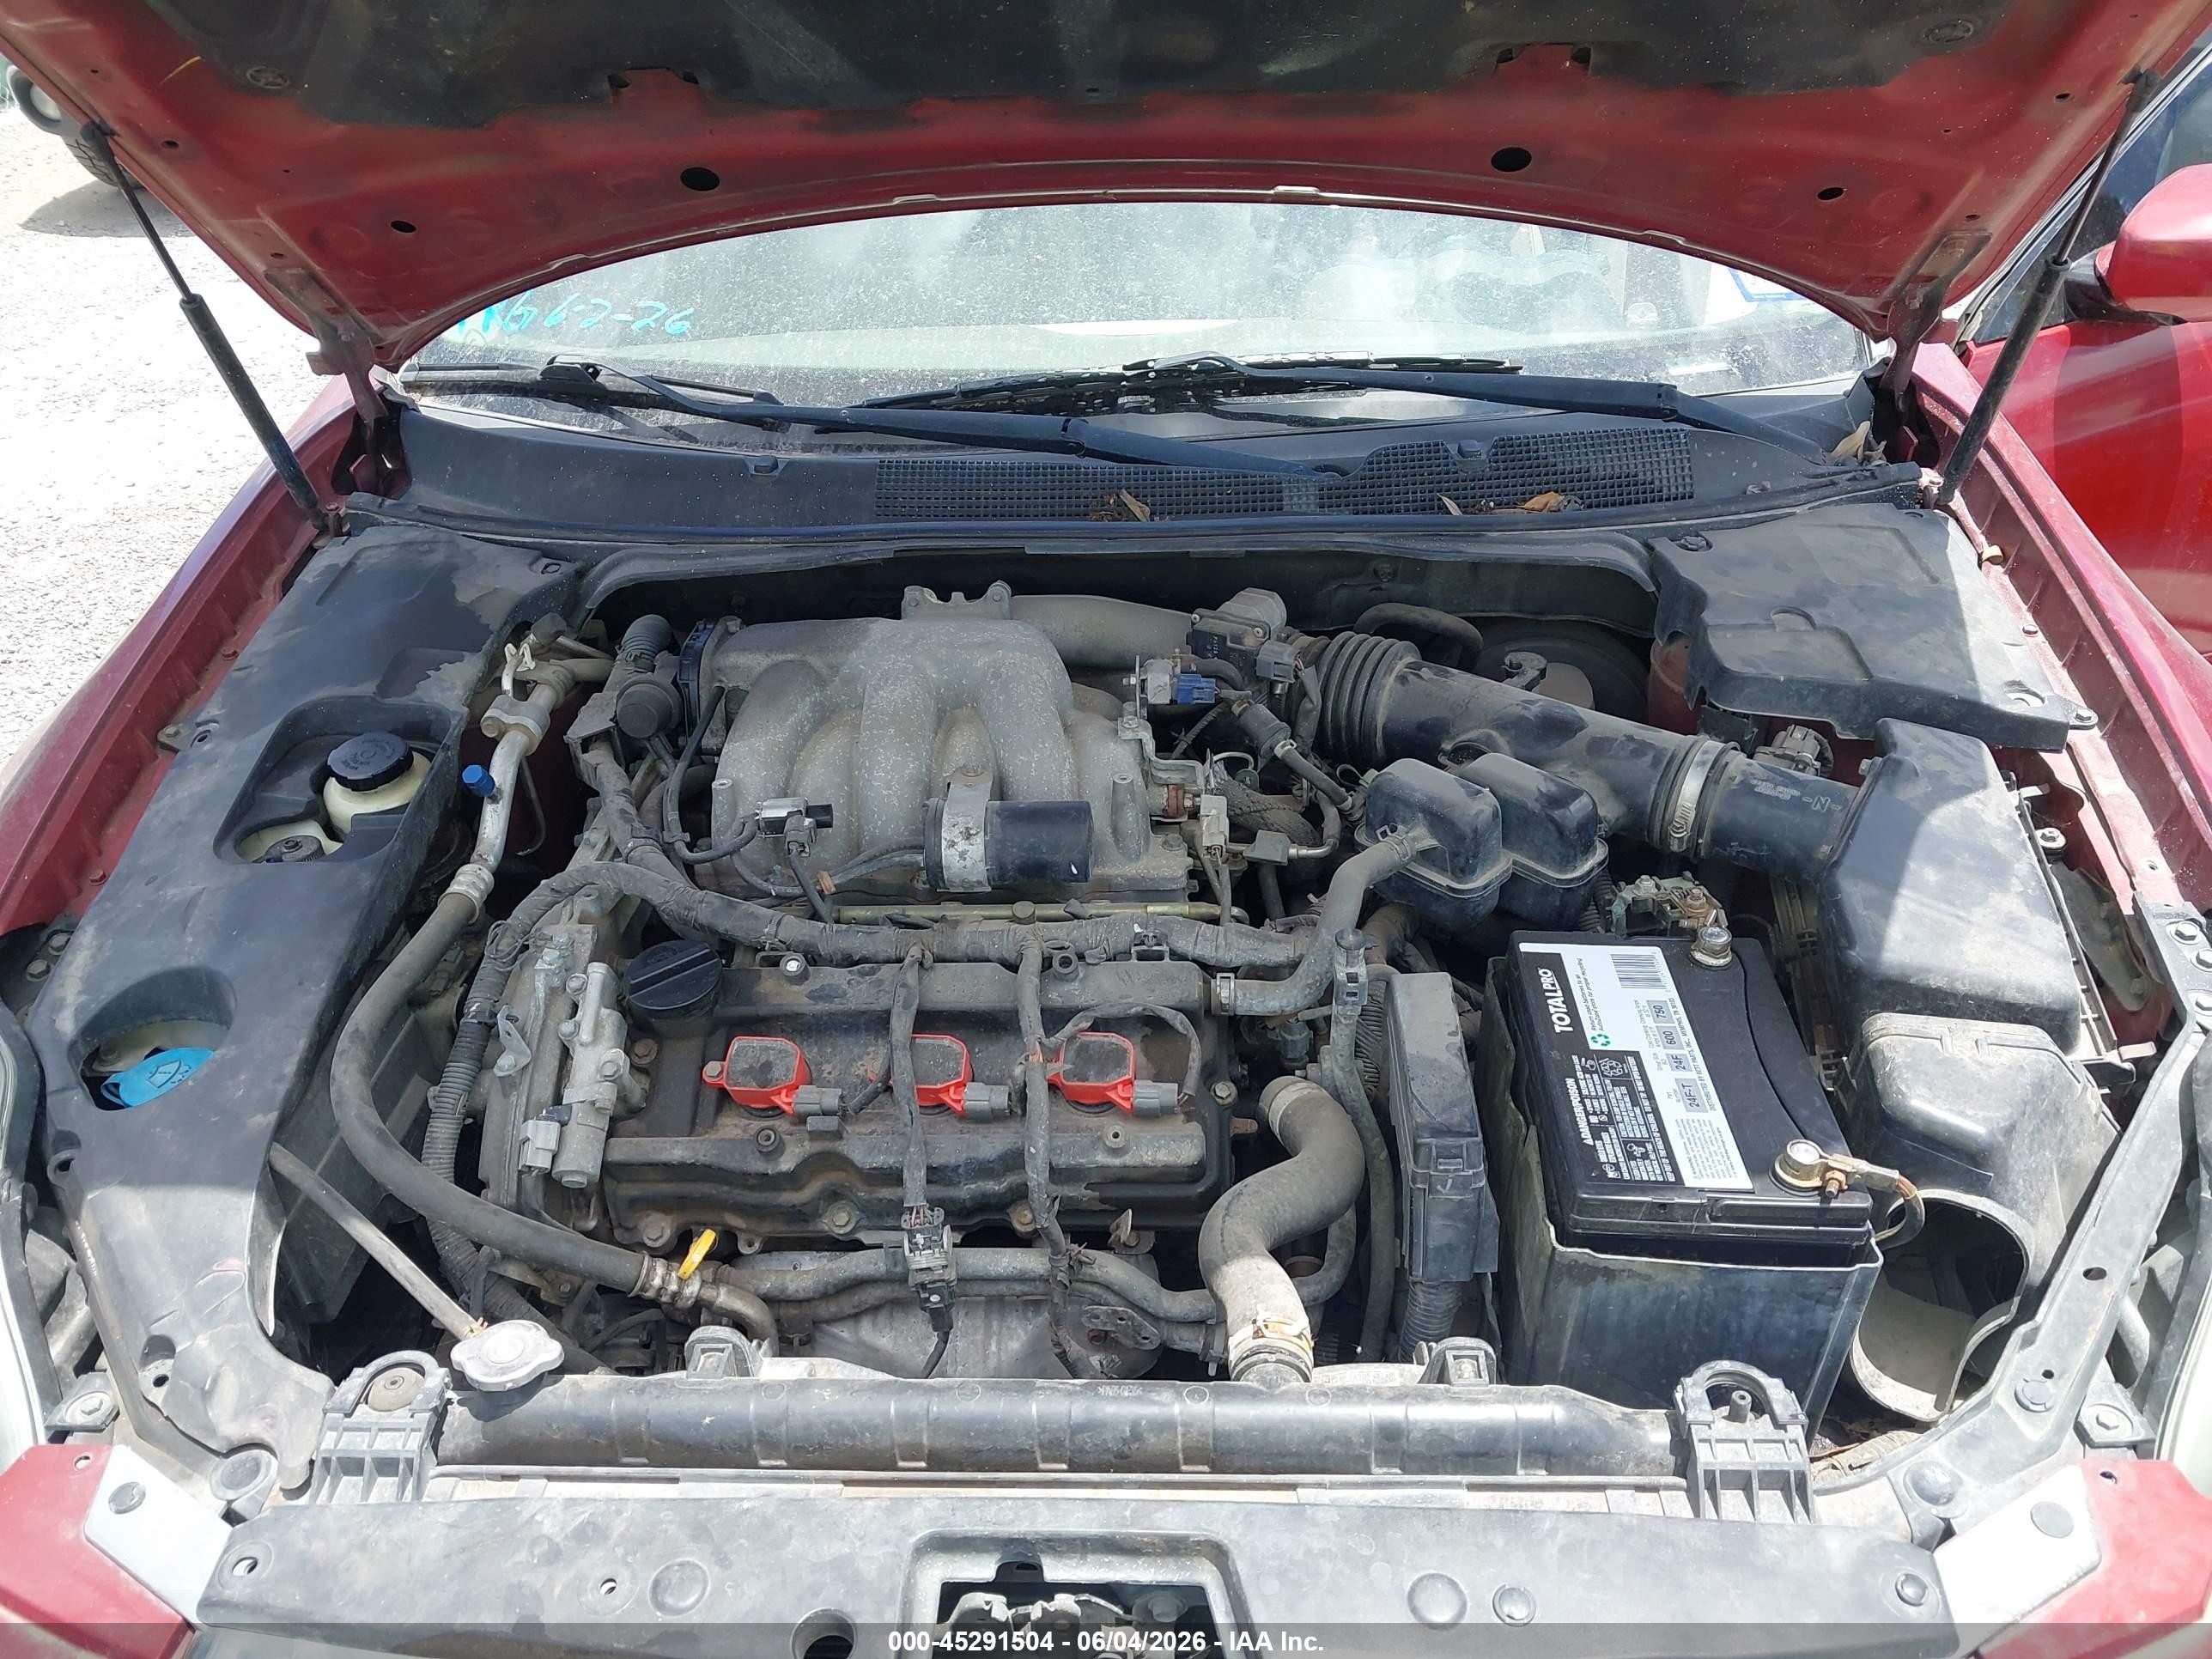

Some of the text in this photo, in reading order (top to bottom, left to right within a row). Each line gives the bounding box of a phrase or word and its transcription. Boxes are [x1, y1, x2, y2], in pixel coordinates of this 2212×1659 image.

[1538, 968, 1574, 1033] TOTALPRO
[1653, 1005, 1667, 1018] 750
[1662, 1030, 1676, 1044] 600
[1672, 1054, 1686, 1069] 24F
[1682, 1083, 1699, 1107] 24F-T
